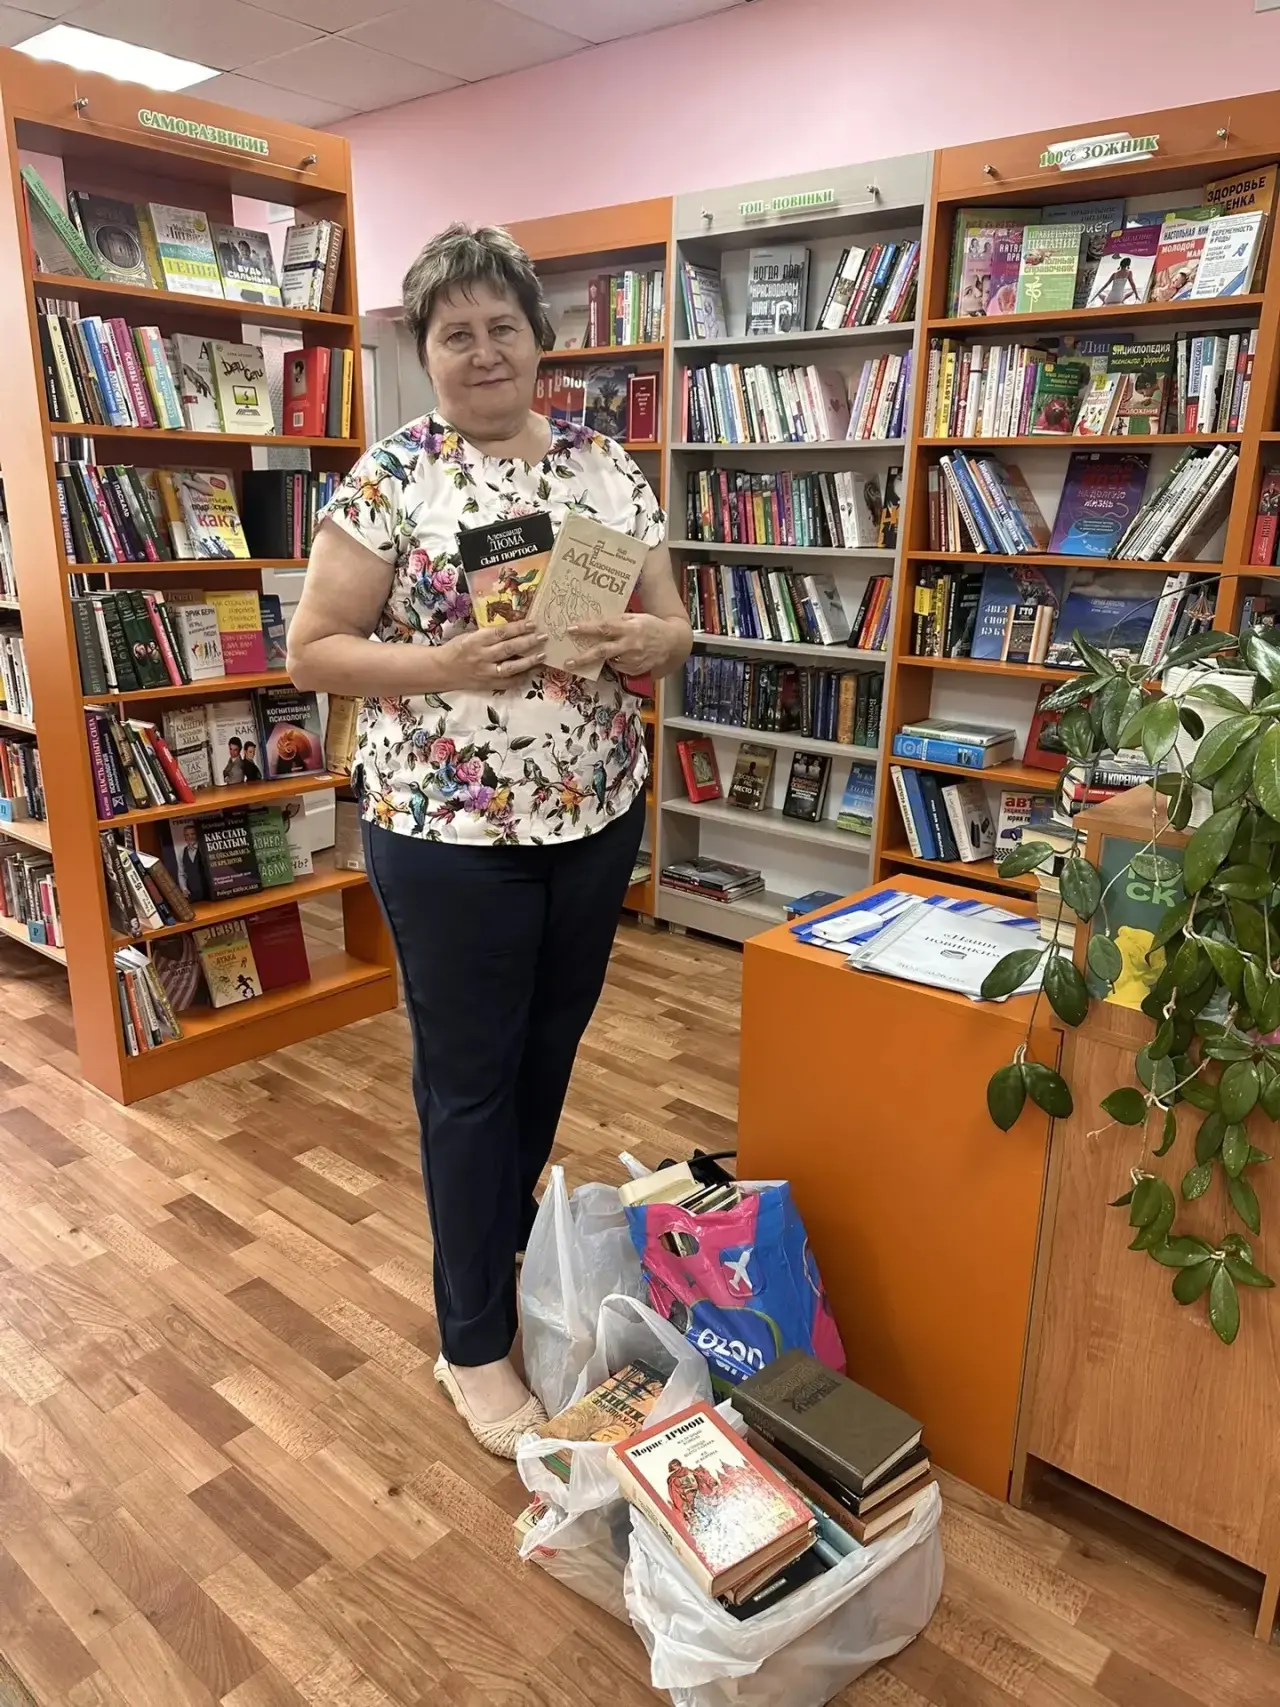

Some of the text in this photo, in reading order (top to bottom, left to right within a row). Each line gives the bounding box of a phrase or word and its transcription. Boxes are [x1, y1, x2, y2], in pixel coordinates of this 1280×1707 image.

[138, 109, 270, 156] САМОРАЗВИТИЕ
[1039, 134, 1160, 168] 100% ЗОЖНИК
[1207, 176, 1266, 203] ЗДОРОВЬЕ
[740, 201, 763, 216] ТОП
[772, 189, 834, 211] НОВИНКИ
[1163, 228, 1195, 241] НАСТОЛЬНАЯ
[1211, 225, 1254, 238] БЕРЕМЕННОСТЬ
[1028, 239, 1079, 250] ПИТАНИЕ
[1161, 242, 1196, 254] МОЛОДОЙ
[167, 260, 218, 278] ГЕНИЯ
[237, 264, 262, 277] БУДЬ
[753, 264, 799, 280] КОГДА ПОД
[1024, 265, 1074, 273] СПРАВОЧНИК
[751, 282, 799, 298] КРАСНОДАРОМ
[1112, 344, 1171, 356] ЭНЦИКЛОПЕДИЯ
[1192, 341, 1203, 394] ГИРУДОТЕРАПИЯ
[124, 351, 149, 418] ОСНОВЫ РЕКЛАМЫ
[114, 483, 130, 518] ПАСКАЛЬ
[1084, 499, 1114, 508] ЖИЗНЬ
[56, 483, 74, 554] ИРВИН ЯЛОМ
[971, 501, 993, 546] ОЛИМПИЙСКИЕ
[486, 527, 523, 543] Александр
[1148, 523, 1172, 553] ЙОГА
[489, 536, 525, 553] ДЮМА
[480, 544, 539, 566] СЫН ПОРТОСА
[185, 608, 215, 618] ЭРИК БЕРН
[984, 604, 1008, 613] ЗВЕЗ
[1019, 606, 1033, 616] ГТО
[984, 615, 1009, 625] СПОР
[266, 705, 311, 716] КОГНИТИВНАЯ
[268, 712, 311, 723] ПСИХОЛОГИЯ
[88, 717, 98, 738] СИЛА
[103, 753, 117, 794] ПСИХОЛОГИЯ
[187, 761, 201, 772] ТАК
[733, 785, 752, 794] МЕСТО
[204, 828, 248, 843] КАК СТАТЬ
[206, 837, 250, 852] БОГАТЫМ,
[203, 921, 244, 942] ЛЕВИ
[216, 954, 237, 966] АТАКА
[697, 1327, 766, 1371] ozon
[591, 1395, 637, 1429] ИСКУШЕНИЕ
[630, 1416, 705, 1458] Морис ДРЮОН
